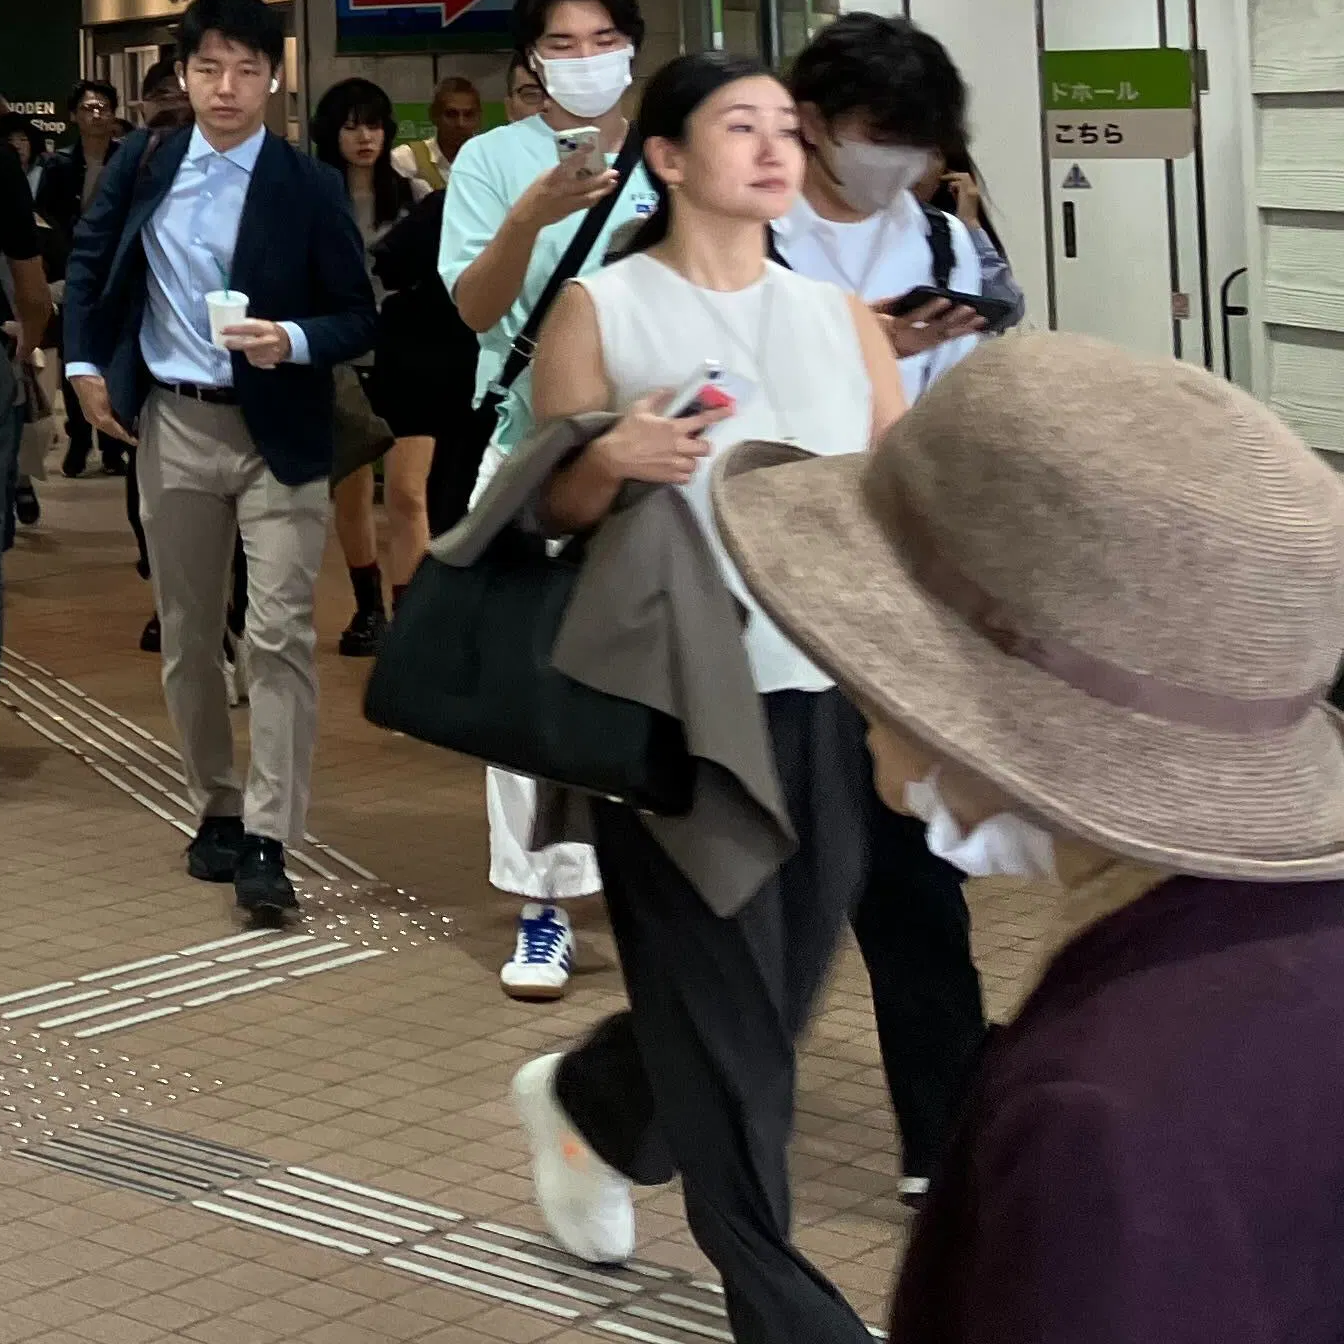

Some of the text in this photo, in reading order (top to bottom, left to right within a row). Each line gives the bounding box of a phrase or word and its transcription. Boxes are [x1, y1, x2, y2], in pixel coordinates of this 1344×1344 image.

[6, 101, 55, 115] NODEN
[1055, 122, 1123, 144] こちら
